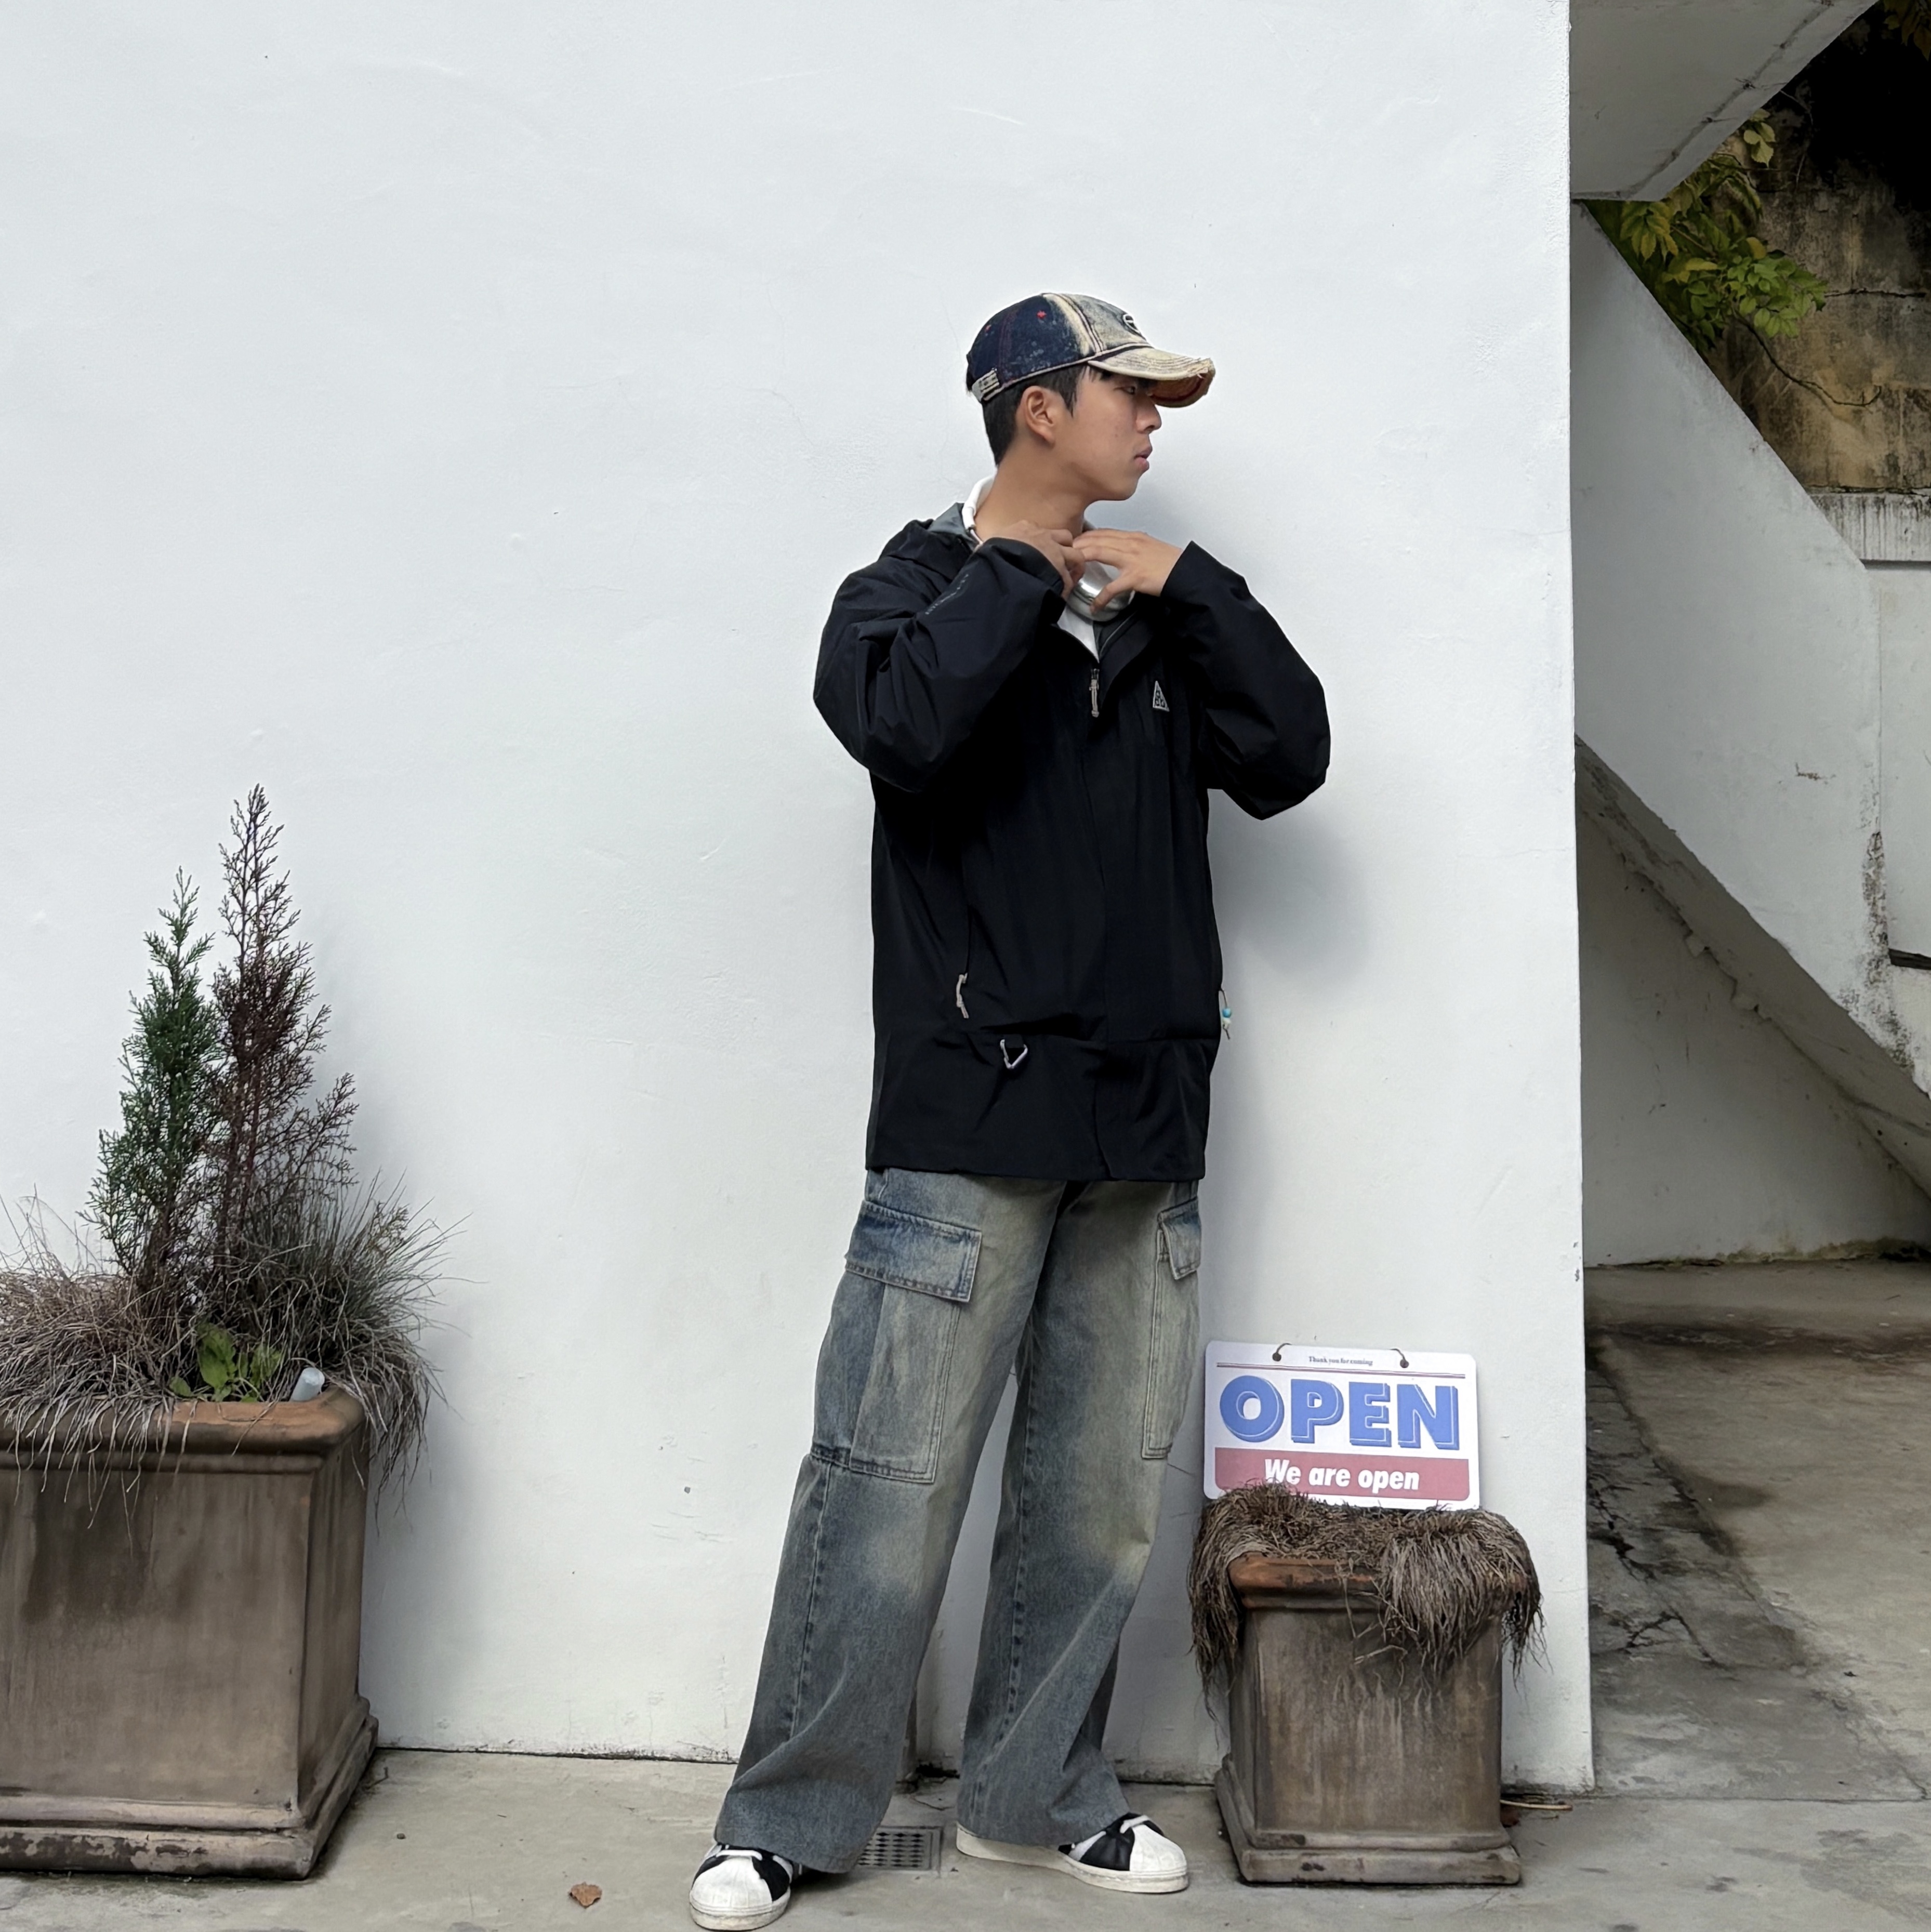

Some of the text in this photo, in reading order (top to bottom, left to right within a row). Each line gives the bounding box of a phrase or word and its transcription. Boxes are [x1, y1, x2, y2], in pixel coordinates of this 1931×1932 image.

[1350, 1357, 1373, 1366] coming
[1220, 1375, 1460, 1450] OPEN
[1265, 1458, 1420, 1494] We are open
